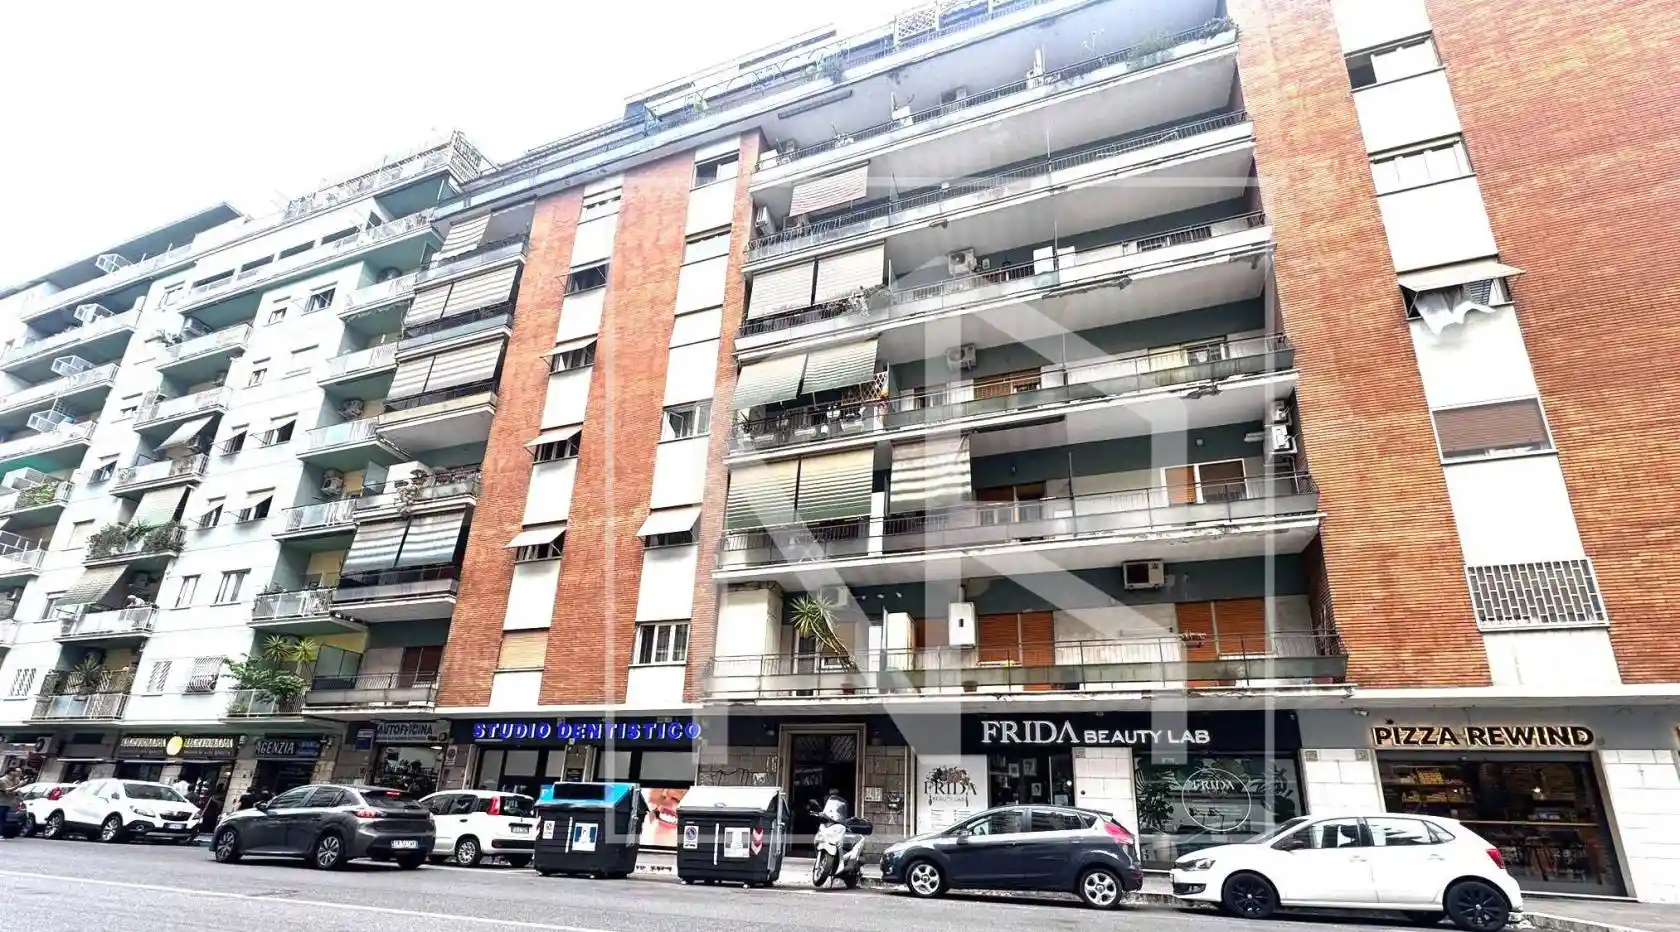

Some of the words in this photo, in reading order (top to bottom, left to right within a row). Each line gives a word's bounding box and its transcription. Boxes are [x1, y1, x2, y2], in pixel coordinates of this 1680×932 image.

[377, 722, 433, 736] AUTOFFICINA
[472, 722, 551, 740] STUDIO
[556, 721, 702, 740] DENTISTICO
[980, 719, 1080, 744] FRIDA
[1084, 729, 1163, 744] BEAUTY
[1167, 729, 1211, 744] LAB
[1371, 725, 1460, 747] PIZZA
[1463, 725, 1595, 747] REWIND
[256, 740, 295, 755] AGENZIA
